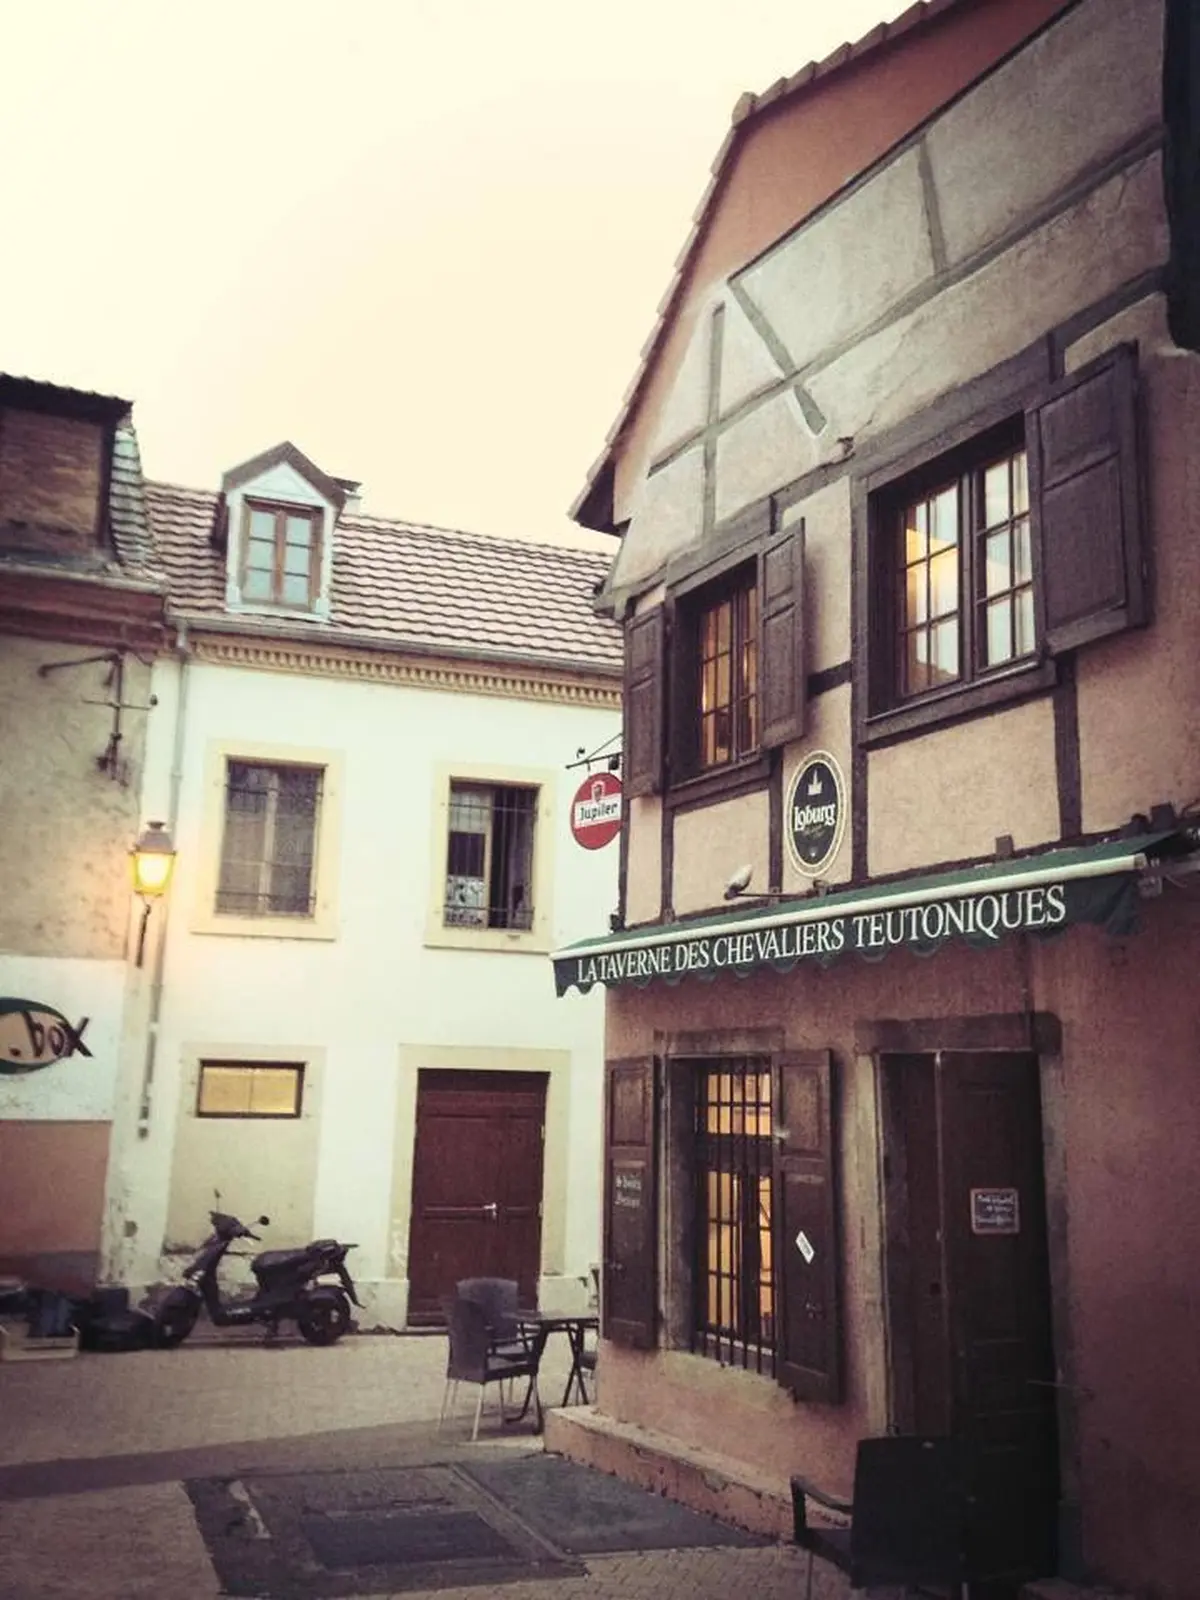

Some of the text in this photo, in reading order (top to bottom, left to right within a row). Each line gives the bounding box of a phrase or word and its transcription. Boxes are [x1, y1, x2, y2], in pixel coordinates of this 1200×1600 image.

[580, 803, 618, 821] Jupiler
[577, 884, 1066, 983] LA TAVERNE DES CHEVALIERS TEUTONIQUES
